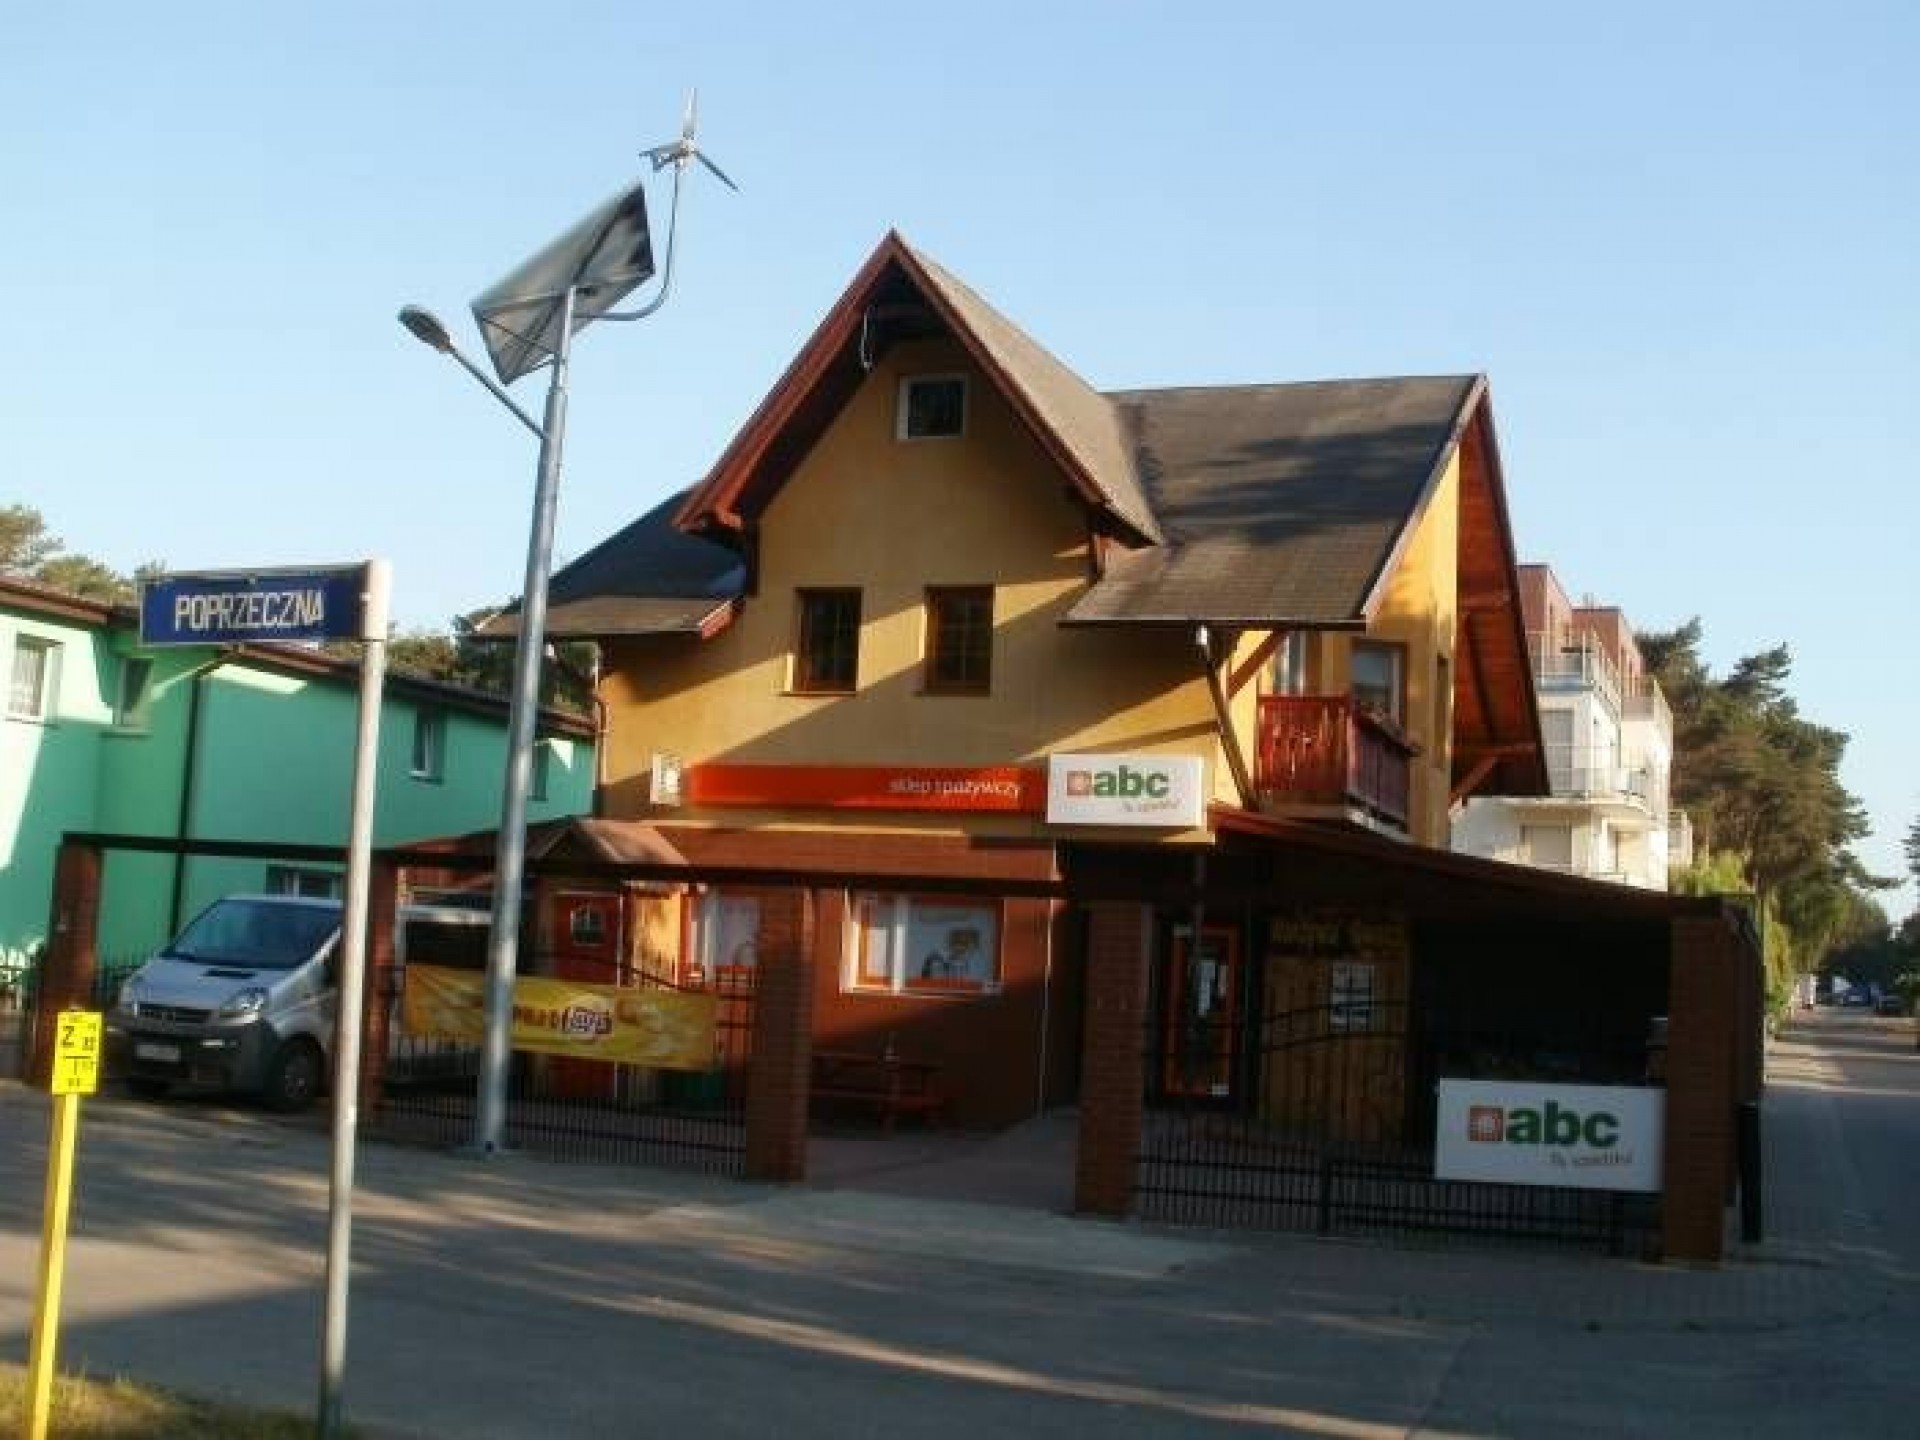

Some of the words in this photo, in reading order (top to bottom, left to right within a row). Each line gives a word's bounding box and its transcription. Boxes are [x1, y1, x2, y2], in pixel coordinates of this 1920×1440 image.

[175, 590, 323, 631] POPRZECZNA
[1093, 765, 1170, 798] abc
[1505, 1100, 1620, 1148] abc
